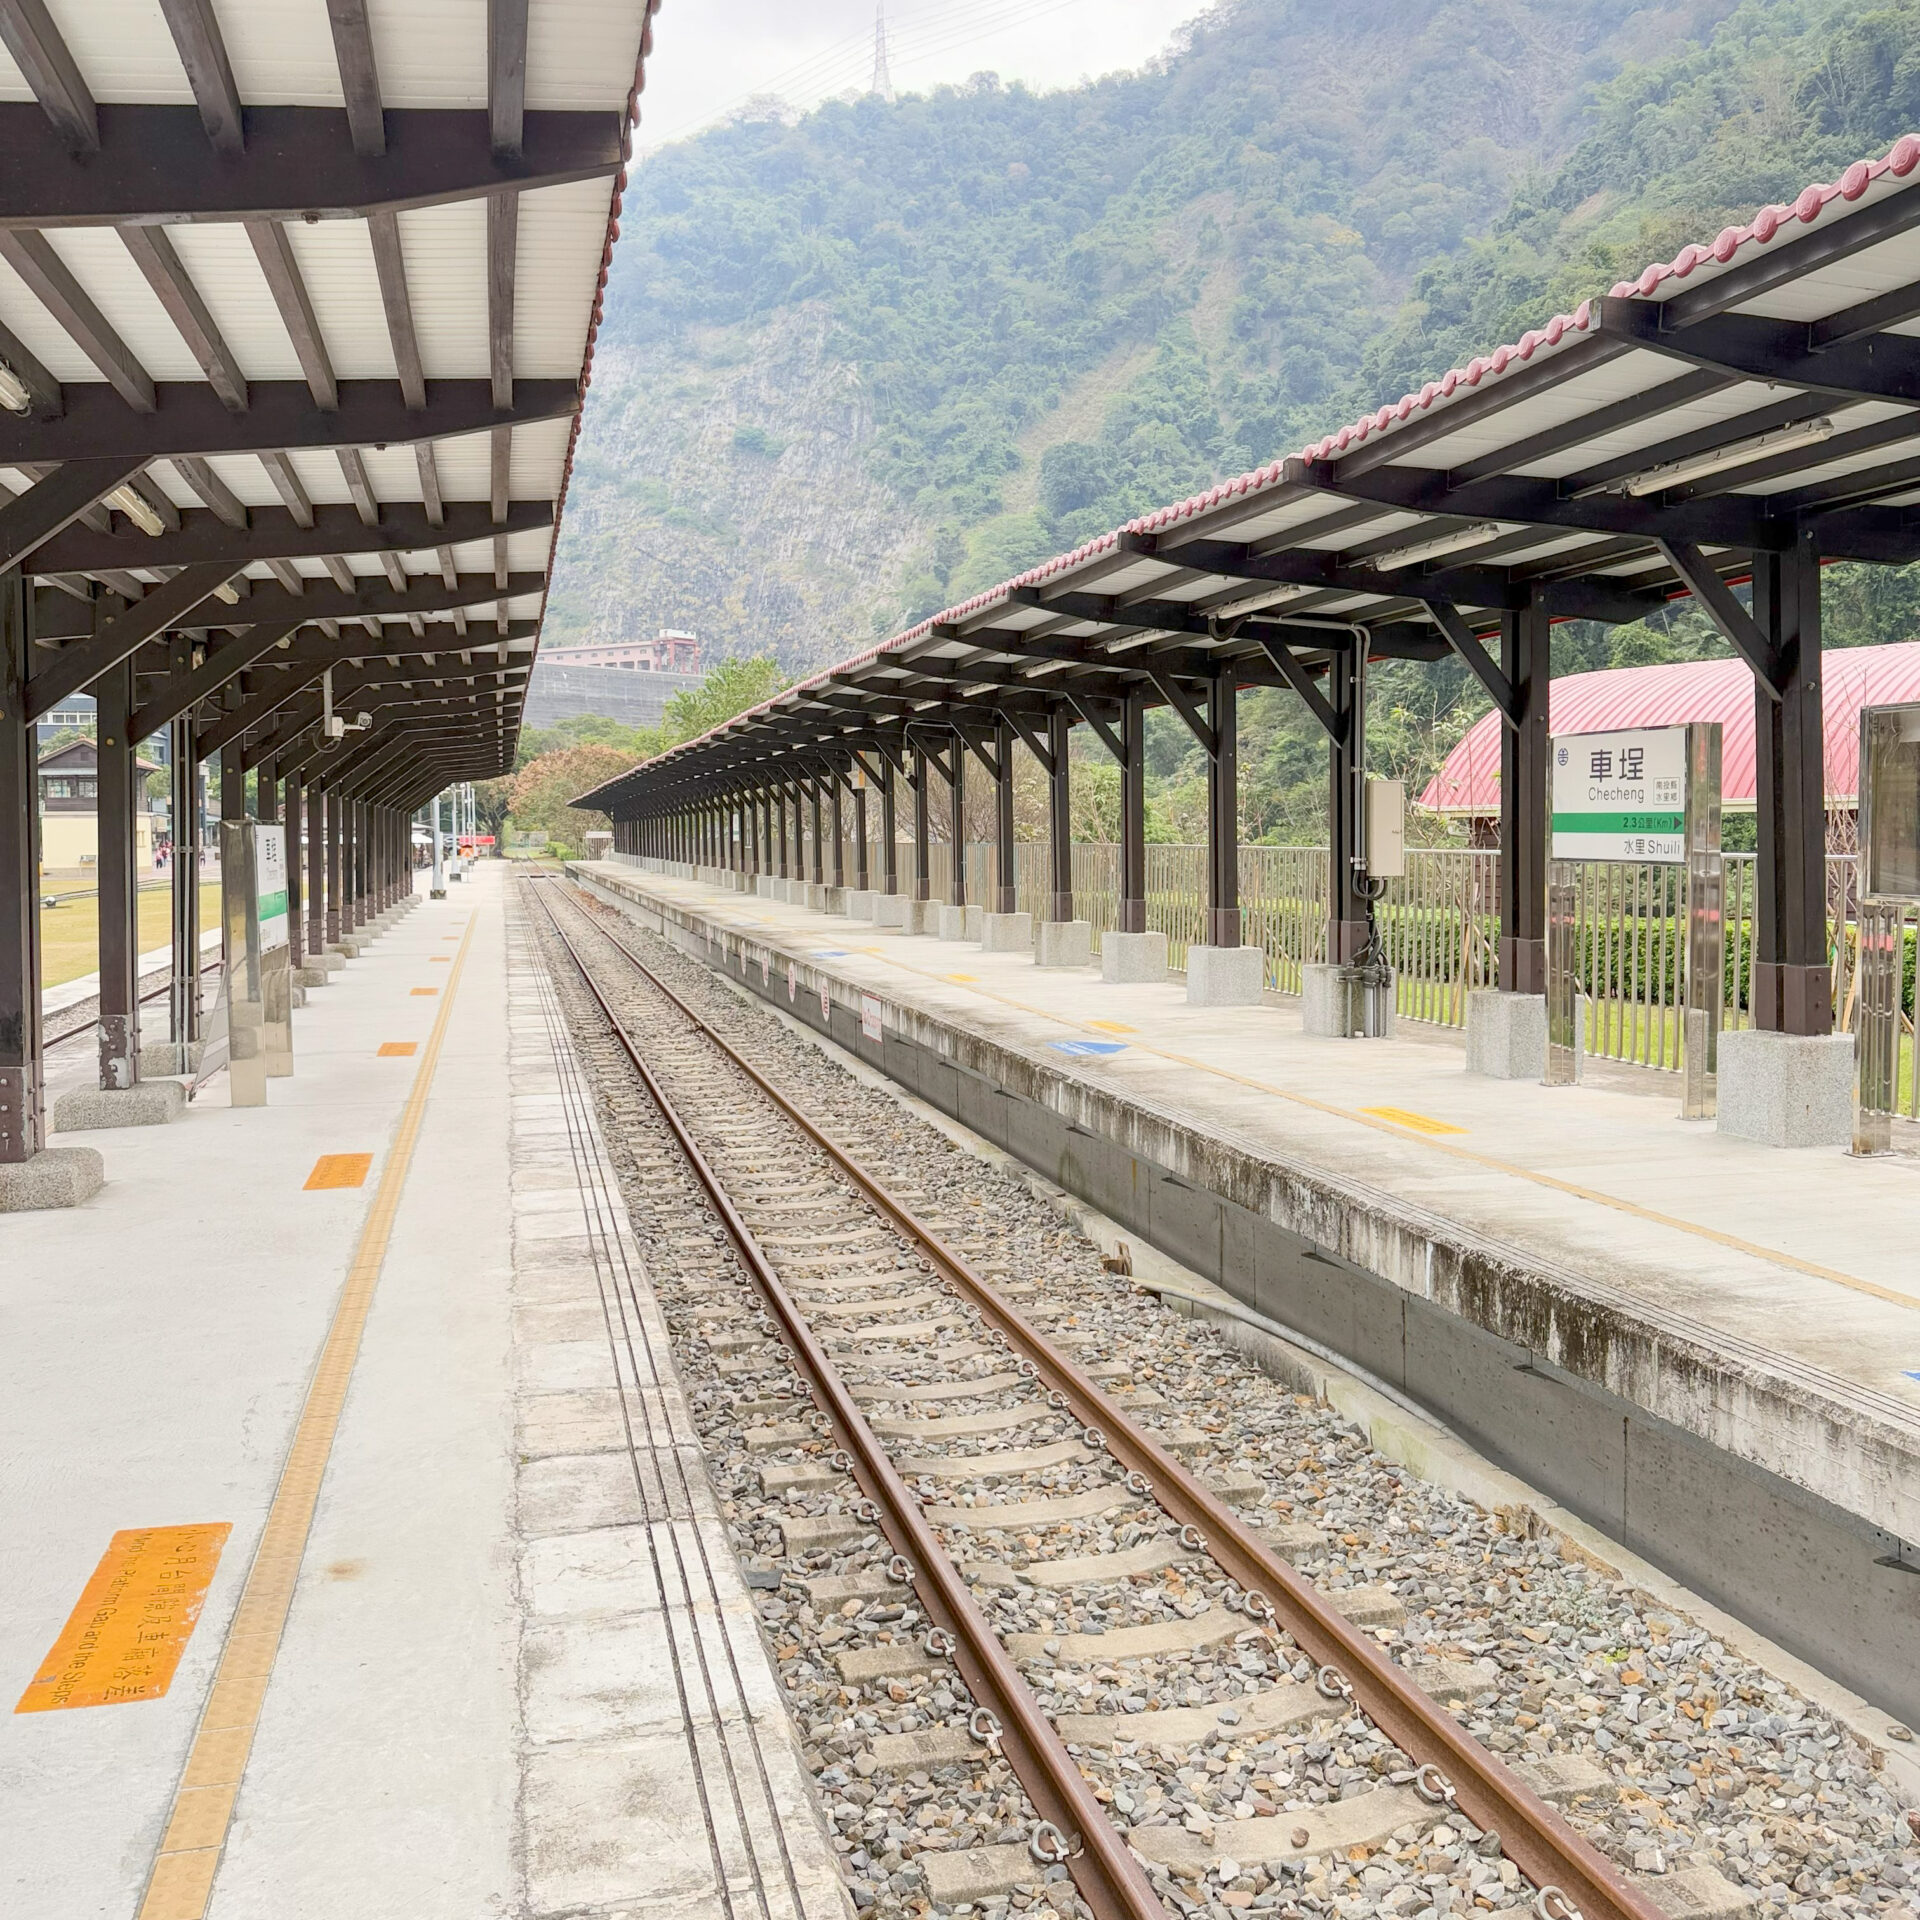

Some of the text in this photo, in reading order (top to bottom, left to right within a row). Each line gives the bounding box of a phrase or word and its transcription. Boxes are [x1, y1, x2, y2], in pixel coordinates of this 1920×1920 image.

[1589, 747, 1644, 783] 車埕
[1588, 786, 1645, 804] Checheng
[1624, 839, 1681, 855] 水里 Shuili
[90, 1607, 118, 1630] Gap
[78, 1630, 102, 1650] and
[68, 1651, 96, 1669] the
[50, 1671, 87, 1705] Steps
